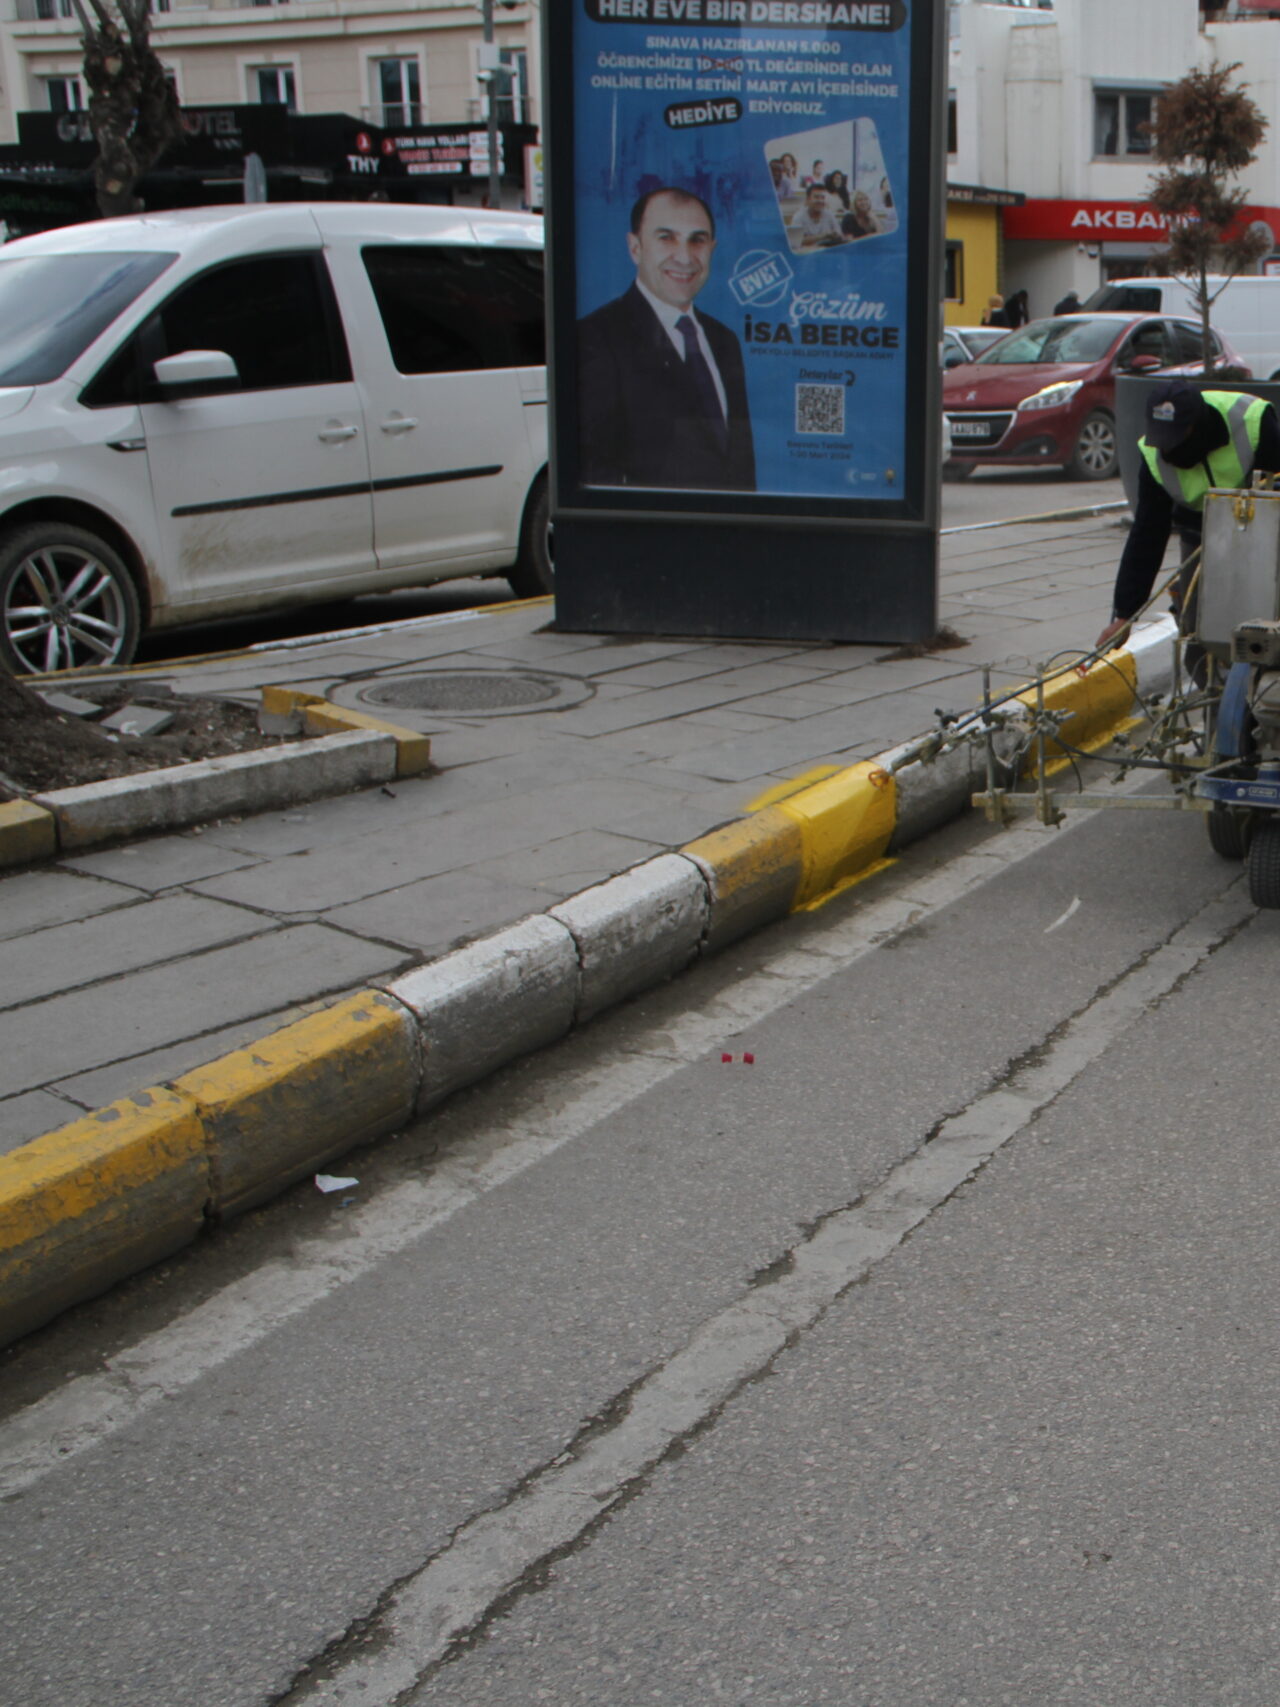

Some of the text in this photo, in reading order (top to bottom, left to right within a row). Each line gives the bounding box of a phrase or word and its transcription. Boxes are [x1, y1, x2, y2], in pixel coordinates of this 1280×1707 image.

[599, 0, 649, 17] HER
[653, 0, 702, 19] EVE
[751, 1, 891, 25] DERSHANE!
[646, 36, 700, 50] SINAVA
[702, 37, 798, 53] HAZIRLANAN
[597, 51, 693, 71] ÖĞRENCİMİZE
[746, 59, 764, 73] TL
[765, 57, 849, 76] DEĞERİNDE
[851, 63, 893, 77] OLAN
[591, 73, 899, 98] ONLİNE EĞİTİM SETİNİ MART AYI İÇERİSİNDE
[668, 98, 827, 126] HEDİYE EDİYORUZ.
[347, 154, 380, 174] THY
[738, 260, 781, 297] EVET
[744, 313, 900, 349] İSA BERGE
